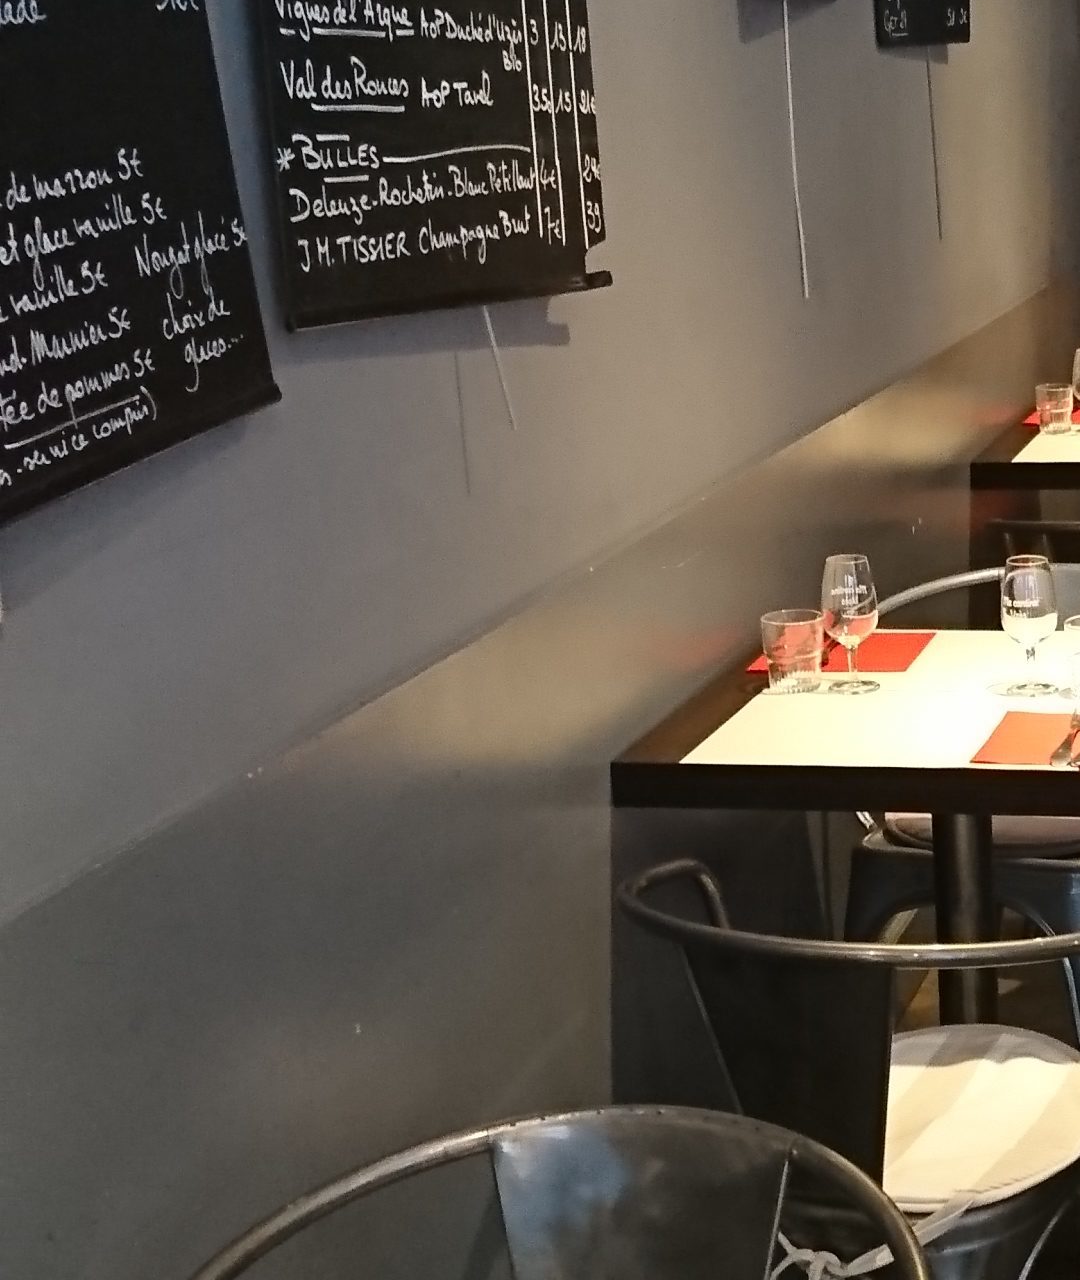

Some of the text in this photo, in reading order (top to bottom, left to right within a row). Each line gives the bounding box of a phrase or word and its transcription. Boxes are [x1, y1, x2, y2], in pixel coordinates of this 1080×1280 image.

[573, 26, 586, 54] 18
[280, 58, 317, 100] Val
[321, 64, 352, 100] des
[555, 88, 572, 114] 15
[291, 133, 380, 170] BULLES
[419, 218, 500, 265] Champagne
[499, 205, 531, 237] Brut
[135, 221, 191, 300] Nougat
[38, 381, 63, 414] de
